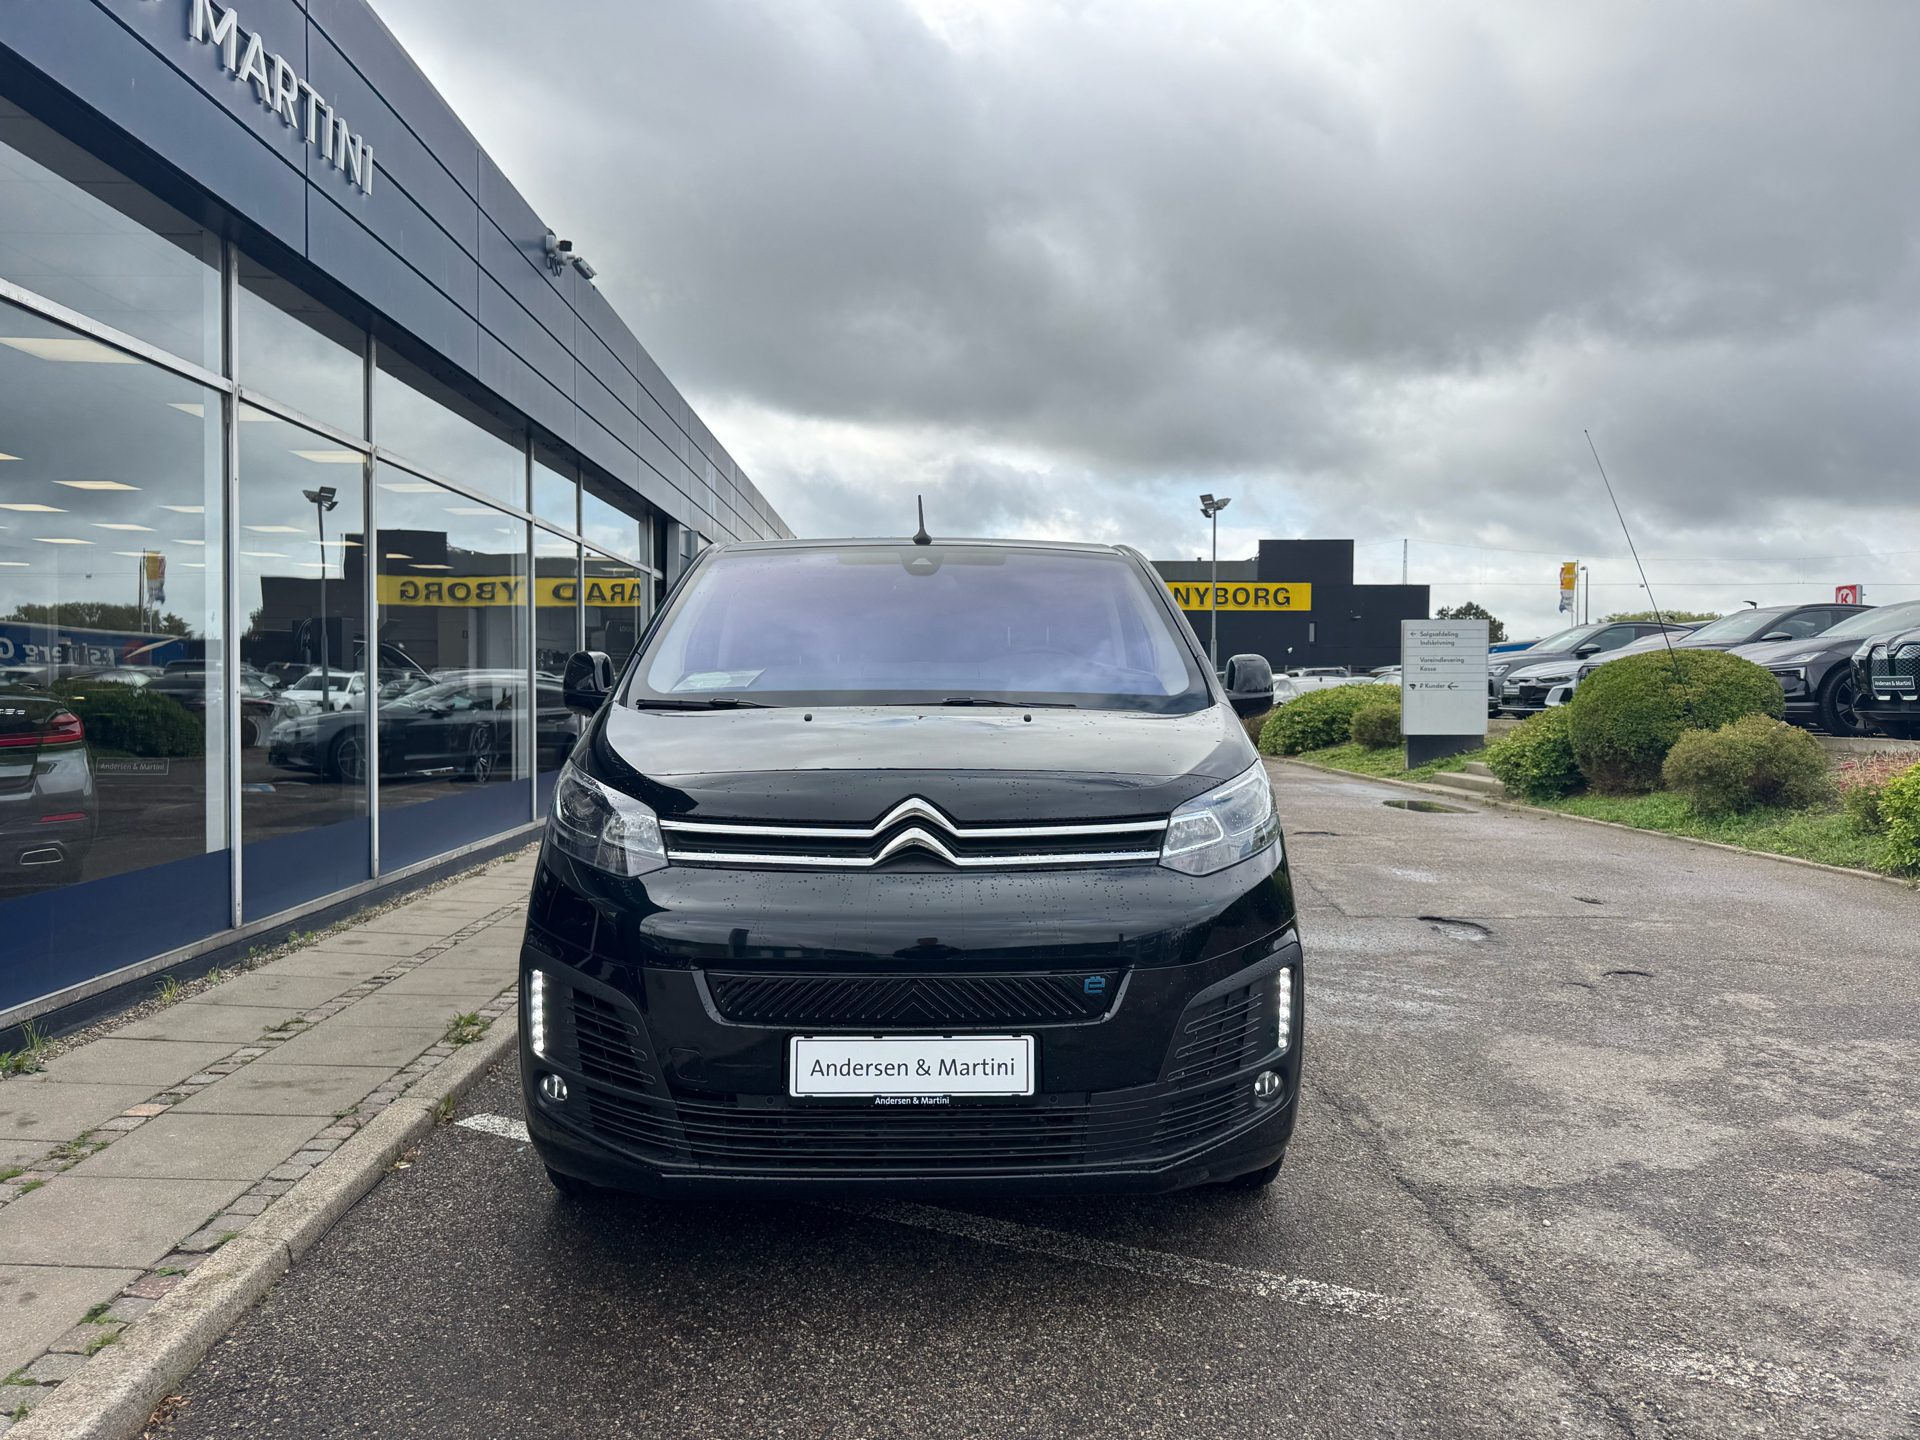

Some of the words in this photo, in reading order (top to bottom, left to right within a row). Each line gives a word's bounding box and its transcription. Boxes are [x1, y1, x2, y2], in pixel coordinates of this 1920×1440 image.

[189, 0, 373, 195] MARTINI
[1173, 587, 1291, 606] NYBORG
[100, 762, 132, 770] Andersen
[140, 762, 165, 770] Martini
[810, 1057, 909, 1077] Andersen
[915, 1058, 932, 1077] &
[938, 1057, 1015, 1077] Martini
[874, 1096, 912, 1105] Andersen
[912, 1097, 919, 1105] &
[920, 1096, 950, 1105] Martini
